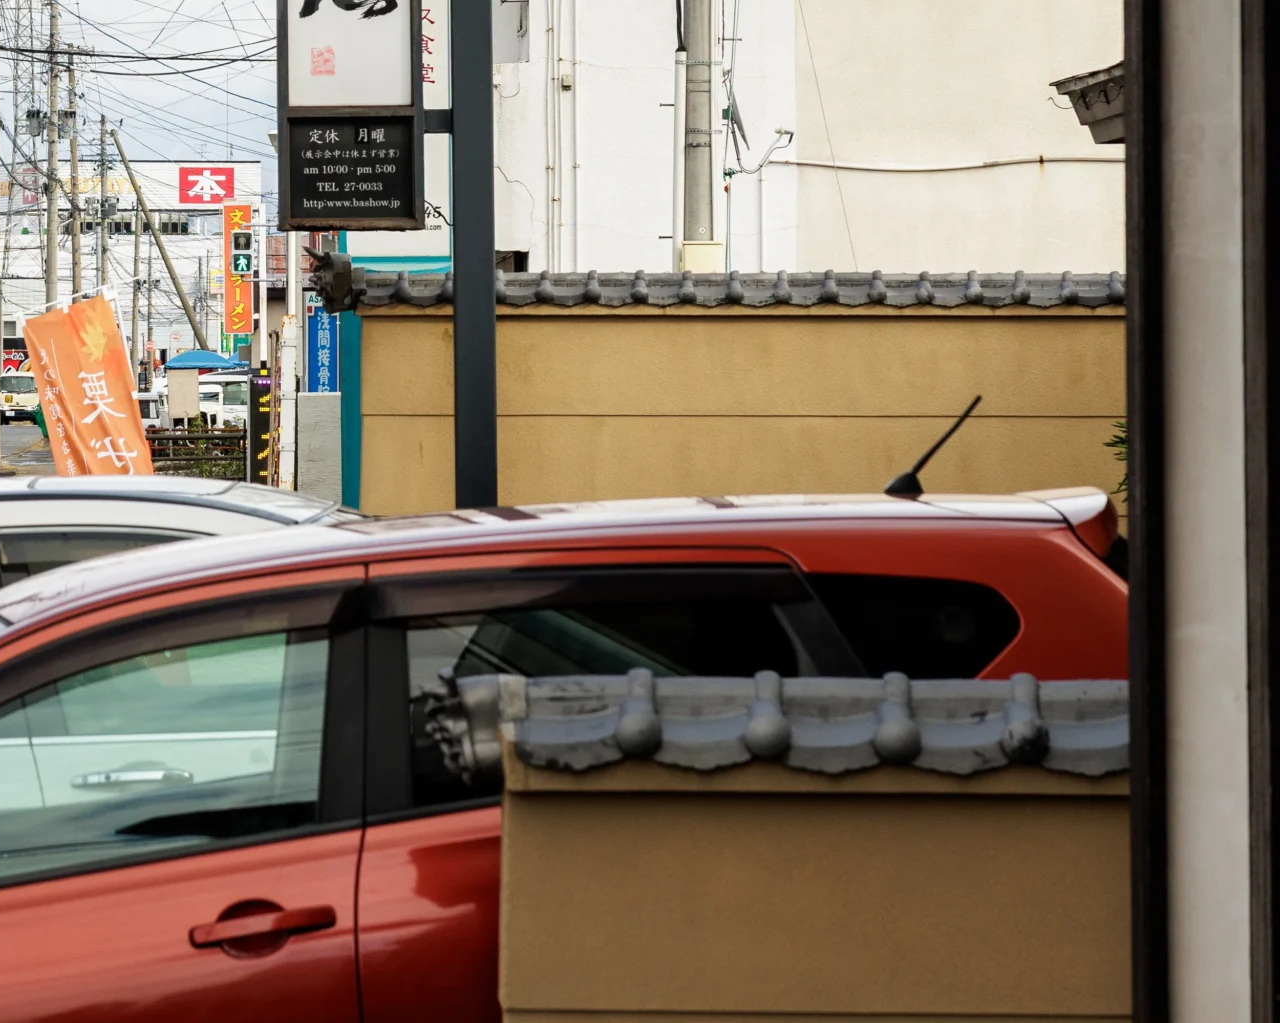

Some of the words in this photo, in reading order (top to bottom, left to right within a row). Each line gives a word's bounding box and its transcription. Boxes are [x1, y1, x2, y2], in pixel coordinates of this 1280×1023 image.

[309, 128, 340, 144] 定休
[357, 128, 386, 143] 月曜
[301, 149, 400, 159] (展示会中は休まず営業)
[303, 166, 319, 174] am
[322, 165, 348, 174] 10:00
[356, 166, 372, 175] pm
[375, 164, 396, 173] 5:00
[187, 170, 226, 202] 本
[317, 182, 339, 192] TEL
[343, 182, 383, 192] 27-0033
[303, 197, 401, 209] http:www.bashow.jp
